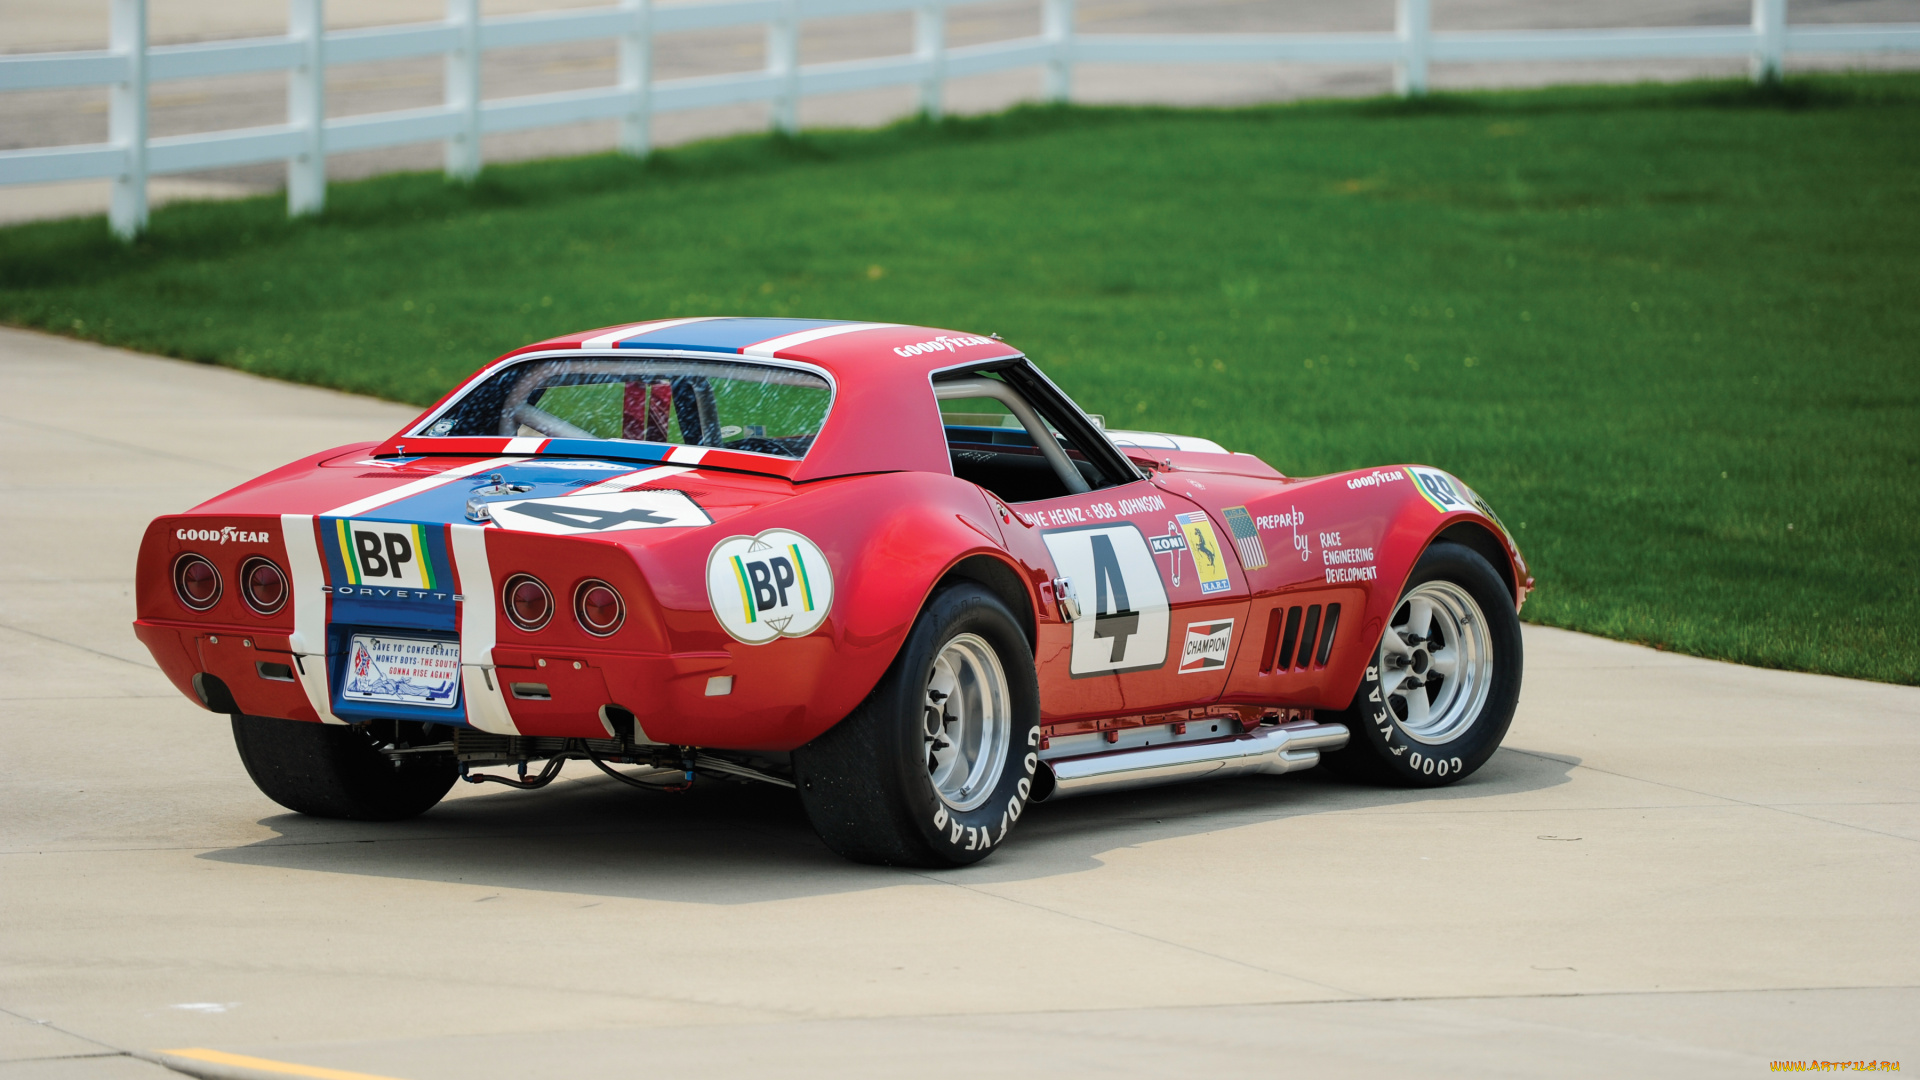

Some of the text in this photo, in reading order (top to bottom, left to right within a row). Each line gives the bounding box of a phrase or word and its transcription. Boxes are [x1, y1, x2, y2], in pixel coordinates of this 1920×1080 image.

[504, 501, 677, 530] 4
[1048, 507, 1086, 525] HEINZ
[1091, 502, 1116, 520] BOB
[1118, 495, 1166, 517] JOHNSON
[1256, 511, 1304, 530] PREPARED
[1291, 505, 1312, 562] by
[1319, 531, 1342, 548] RACE
[1153, 536, 1185, 551] KONI
[354, 530, 412, 578] BP
[1323, 547, 1374, 566] ENGINEERING
[745, 556, 795, 612] BP
[1325, 565, 1378, 584] DEVELOPMENT
[322, 585, 466, 602] CORVETTE
[1090, 534, 1139, 663] 4
[372, 643, 390, 652] SAVE
[406, 645, 459, 657] CONFEDERATE
[1186, 636, 1227, 655] CHAMPION
[376, 655, 398, 664] MONEY
[434, 658, 458, 669] SOUTH
[388, 667, 453, 679] GONNA RISE AGAIN!
